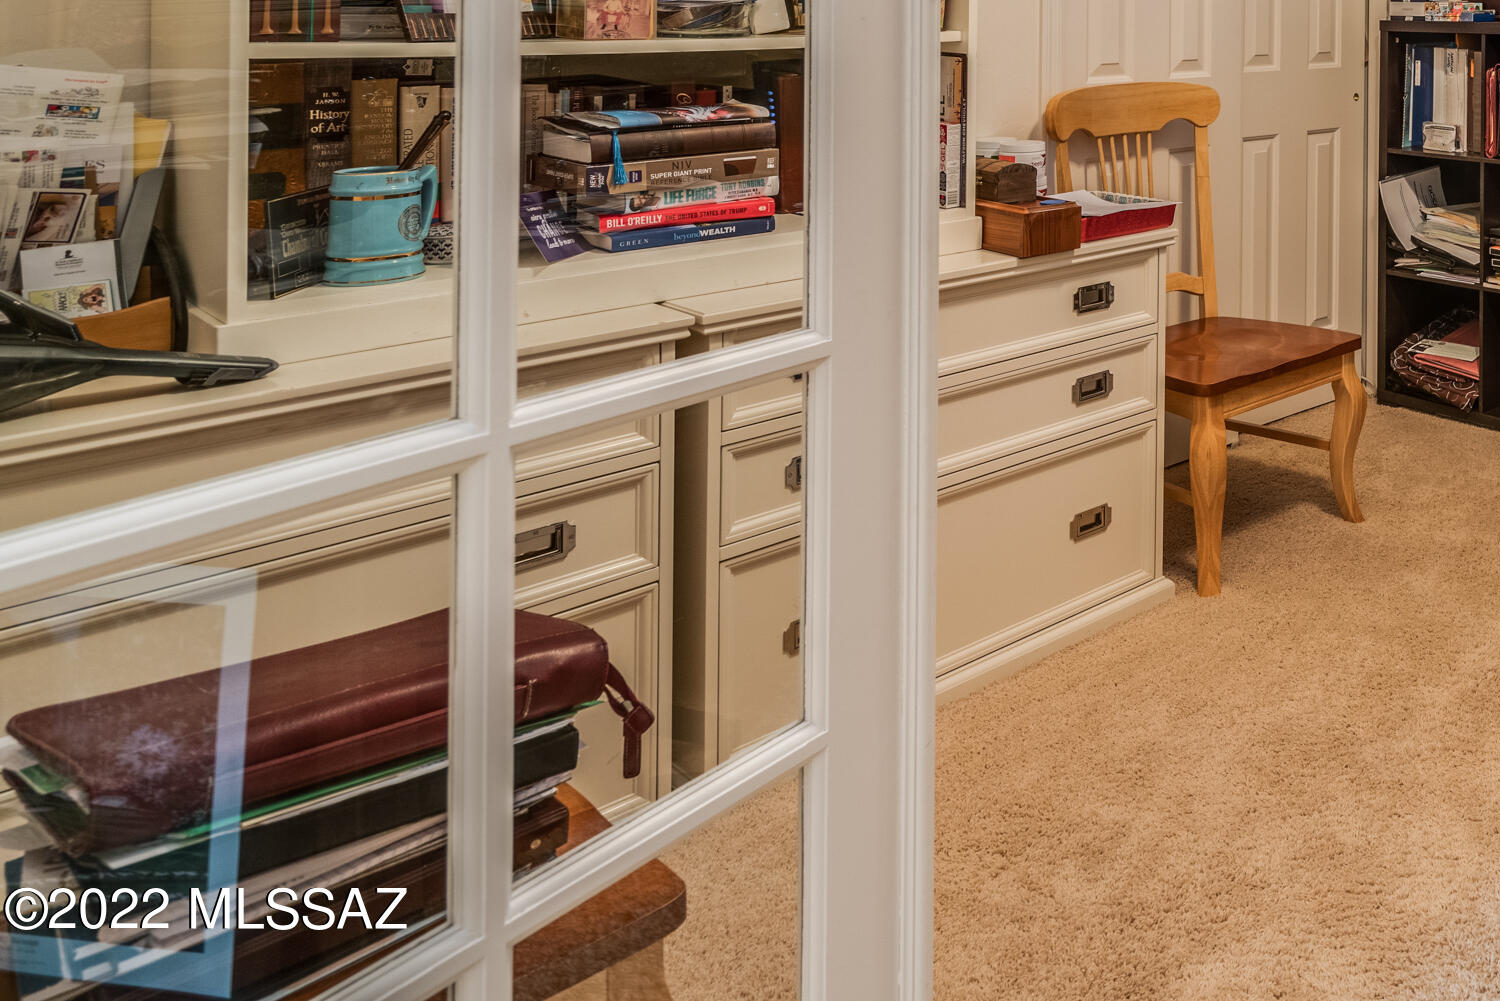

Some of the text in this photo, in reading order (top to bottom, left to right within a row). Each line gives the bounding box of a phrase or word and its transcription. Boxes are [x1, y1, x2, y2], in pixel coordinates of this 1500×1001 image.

[309, 109, 350, 123] History
[310, 122, 345, 134] of Art
[671, 160, 692, 170] NIV
[650, 167, 713, 180] SUPER GIANT PRINT
[663, 190, 684, 206] LIFE
[685, 186, 717, 202] FORCE
[700, 210, 720, 218] STATES
[606, 214, 663, 229] BILL O'REILLY
[619, 238, 649, 247] GREEN
